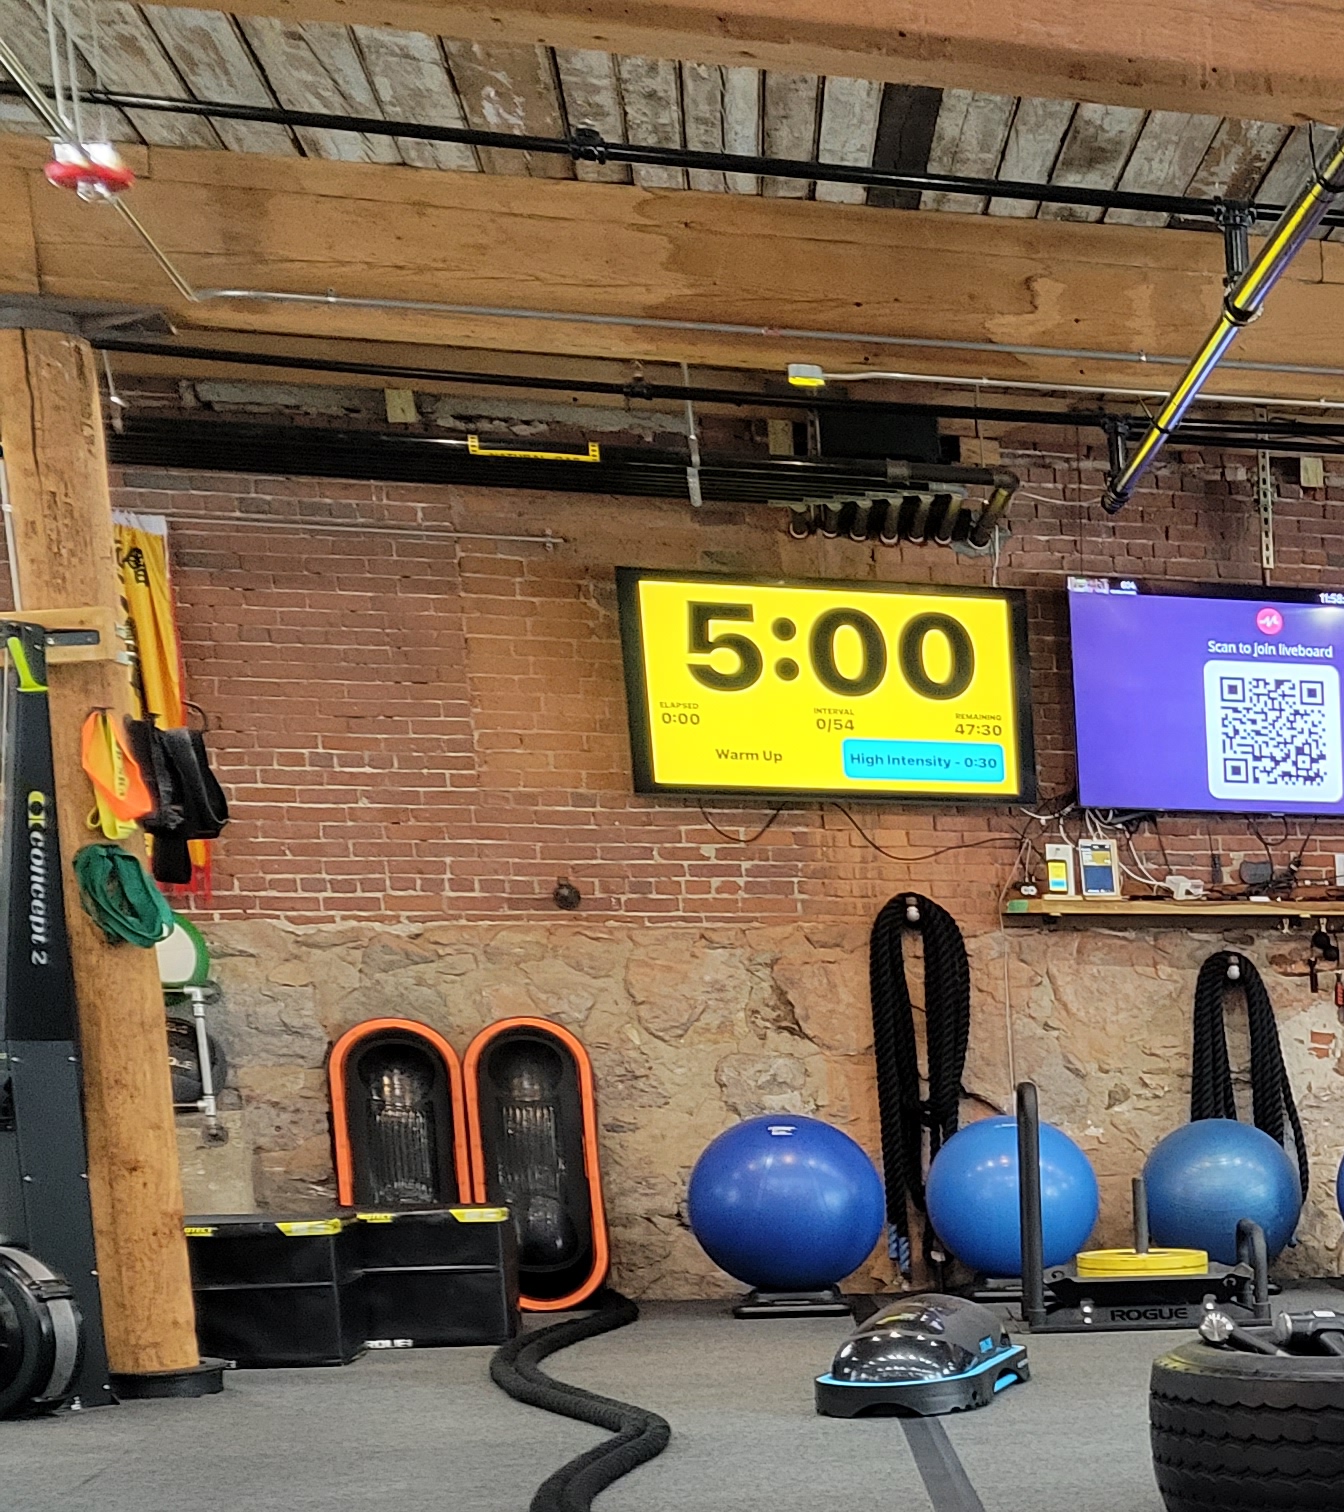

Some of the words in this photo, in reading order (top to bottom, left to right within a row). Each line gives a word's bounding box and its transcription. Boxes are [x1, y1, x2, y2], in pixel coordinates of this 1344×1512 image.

[686, 599, 976, 701] 5:00
[1207, 640, 1236, 656] Scan
[1238, 642, 1251, 656] to
[1252, 641, 1276, 659] join
[1278, 641, 1334, 659] liveboard
[659, 701, 700, 710] ELAPSED
[813, 707, 855, 716] INTERVAL
[660, 711, 701, 726] 0:00
[815, 717, 856, 732] 0/54
[954, 712, 1003, 722] REMAINING
[953, 722, 1003, 737] 47:30
[714, 747, 760, 762] Warm
[762, 749, 783, 764] Up
[849, 752, 885, 768] High
[886, 754, 951, 770] Intensity
[963, 756, 998, 769] 0:30
[29, 830, 48, 945] concept
[31, 949, 48, 966] 2
[1109, 1307, 1188, 1322] ROGUE
